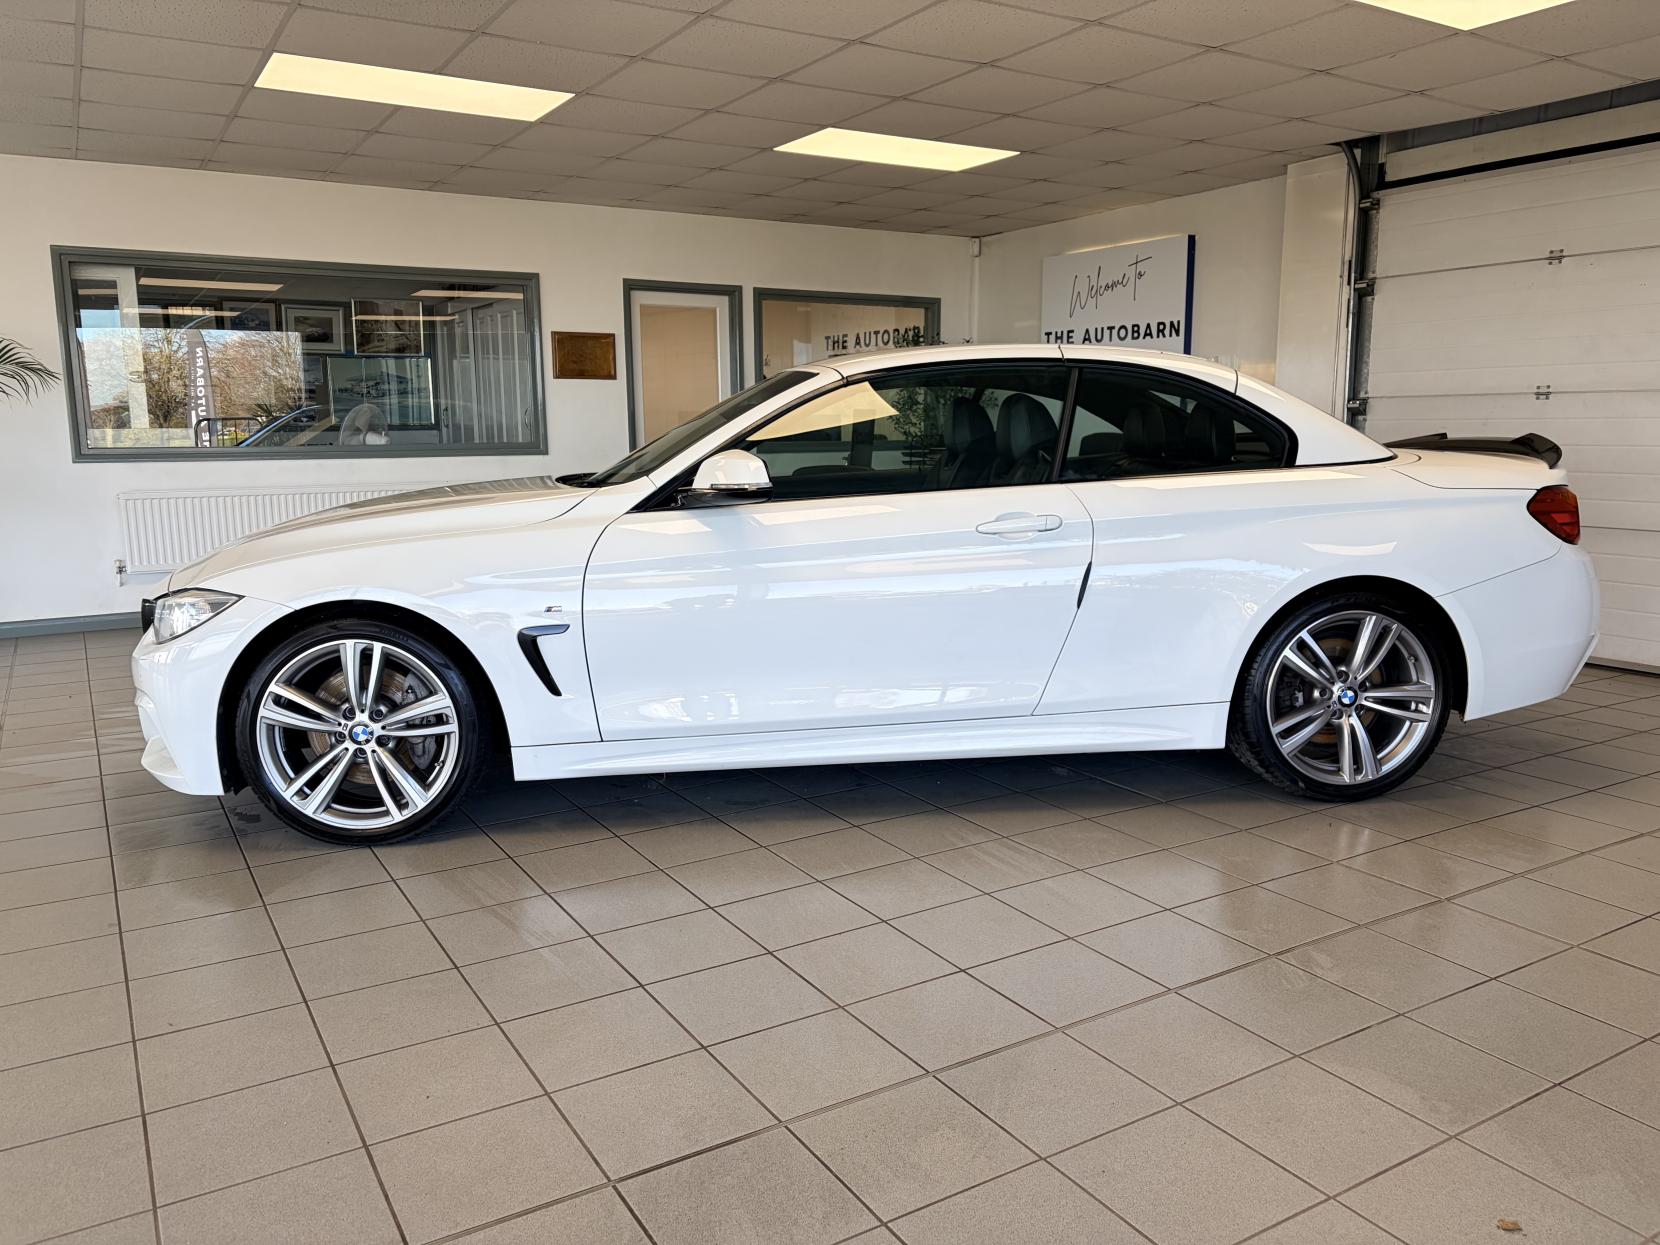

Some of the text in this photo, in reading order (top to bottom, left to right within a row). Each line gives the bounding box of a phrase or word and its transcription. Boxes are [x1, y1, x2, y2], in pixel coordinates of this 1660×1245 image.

[1069, 254, 1153, 319] Welcome to
[824, 332, 849, 352] THE
[1044, 319, 1182, 345] THE AUTOBARN
